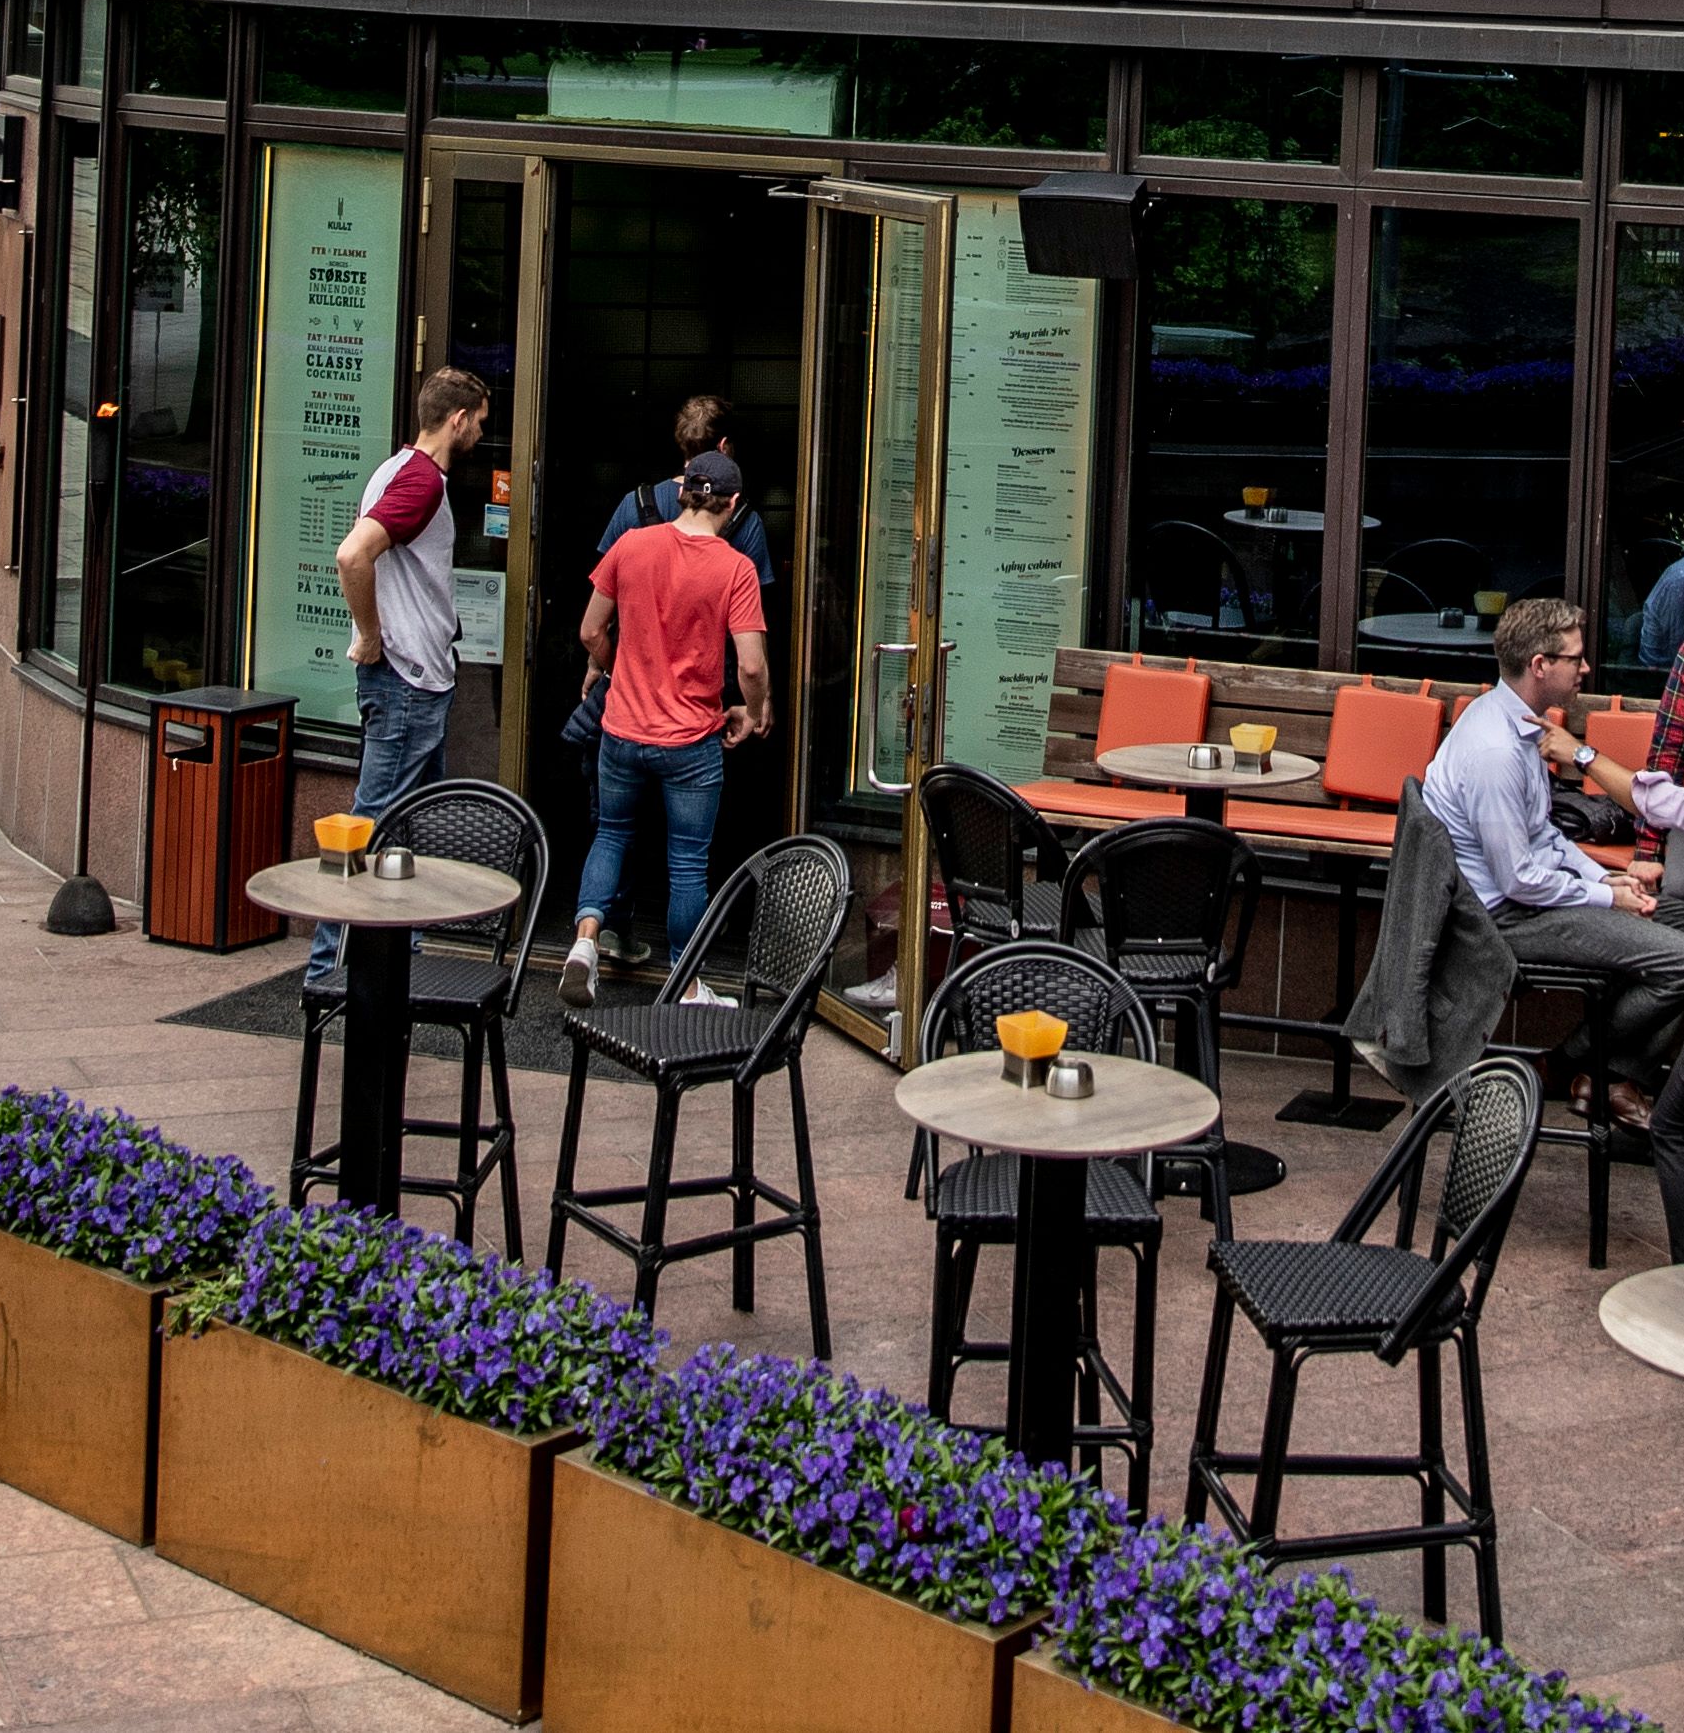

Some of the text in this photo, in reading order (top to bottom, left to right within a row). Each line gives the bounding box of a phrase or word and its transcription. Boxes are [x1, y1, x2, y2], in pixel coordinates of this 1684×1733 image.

[327, 221, 353, 231] KULLT
[311, 246, 367, 258] FYR FLAMME
[309, 267, 367, 284] STØRSTE
[309, 282, 366, 296] INNENDØRS
[308, 293, 366, 308] KULLGRILL
[307, 332, 363, 345] FAT FLASKER
[306, 353, 363, 371] CLASSY
[306, 368, 362, 382] COCKTAILS
[311, 390, 356, 402] TAP VINN
[304, 401, 361, 413] SHUFFLEBOARD
[304, 410, 361, 428] FLIPPER
[303, 424, 322, 433] DART
[331, 427, 361, 437] BILJARD
[321, 448, 329, 458] 23
[1012, 446, 1056, 457] Desserts
[298, 562, 319, 573] FOLK
[1027, 559, 1062, 571] cabinet
[297, 580, 311, 594] PÅ
[296, 614, 319, 624] ELLER
[1035, 672, 1048, 684] pig
